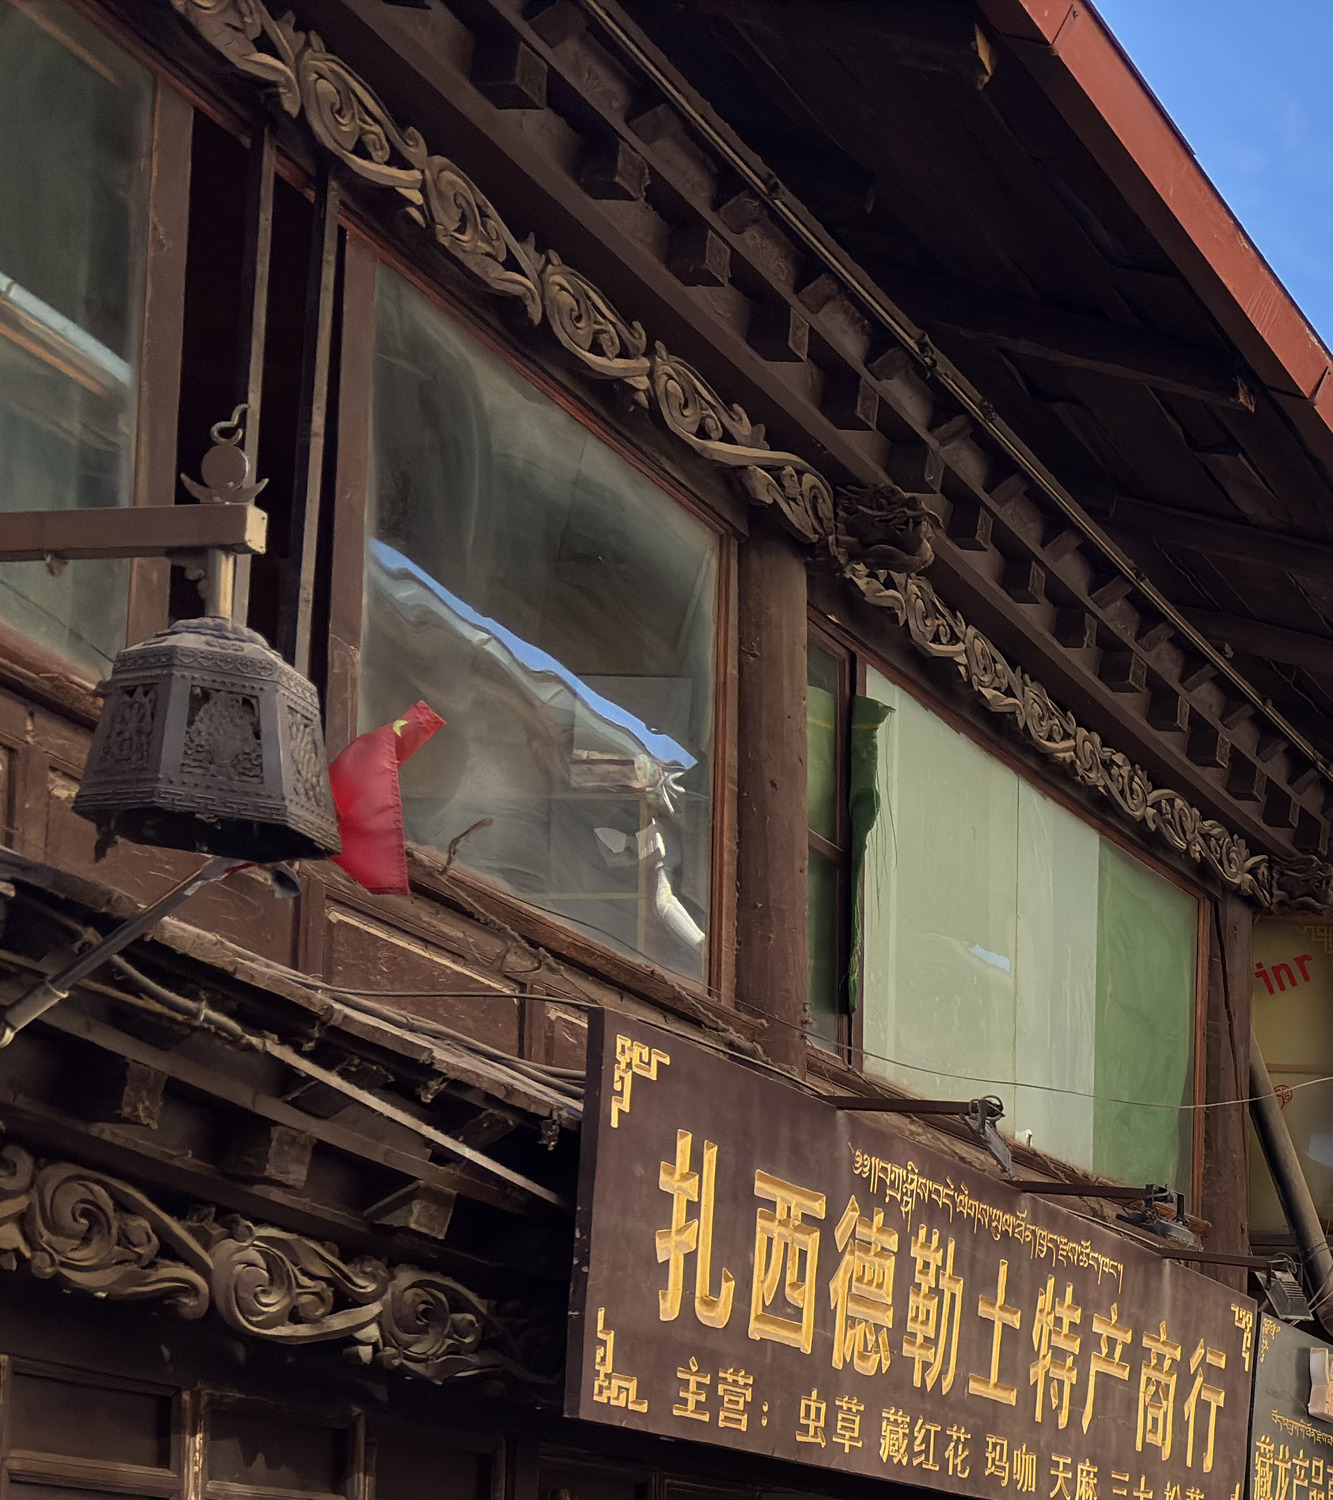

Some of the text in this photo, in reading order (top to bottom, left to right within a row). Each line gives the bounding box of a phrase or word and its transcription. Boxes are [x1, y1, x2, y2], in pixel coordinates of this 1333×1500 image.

[655, 1128, 1228, 1475] 扎西德勒土特产商行
[796, 1388, 865, 1453] 虫草
[879, 1406, 972, 1479] 藏红花
[984, 1433, 1037, 1494] 玛咖
